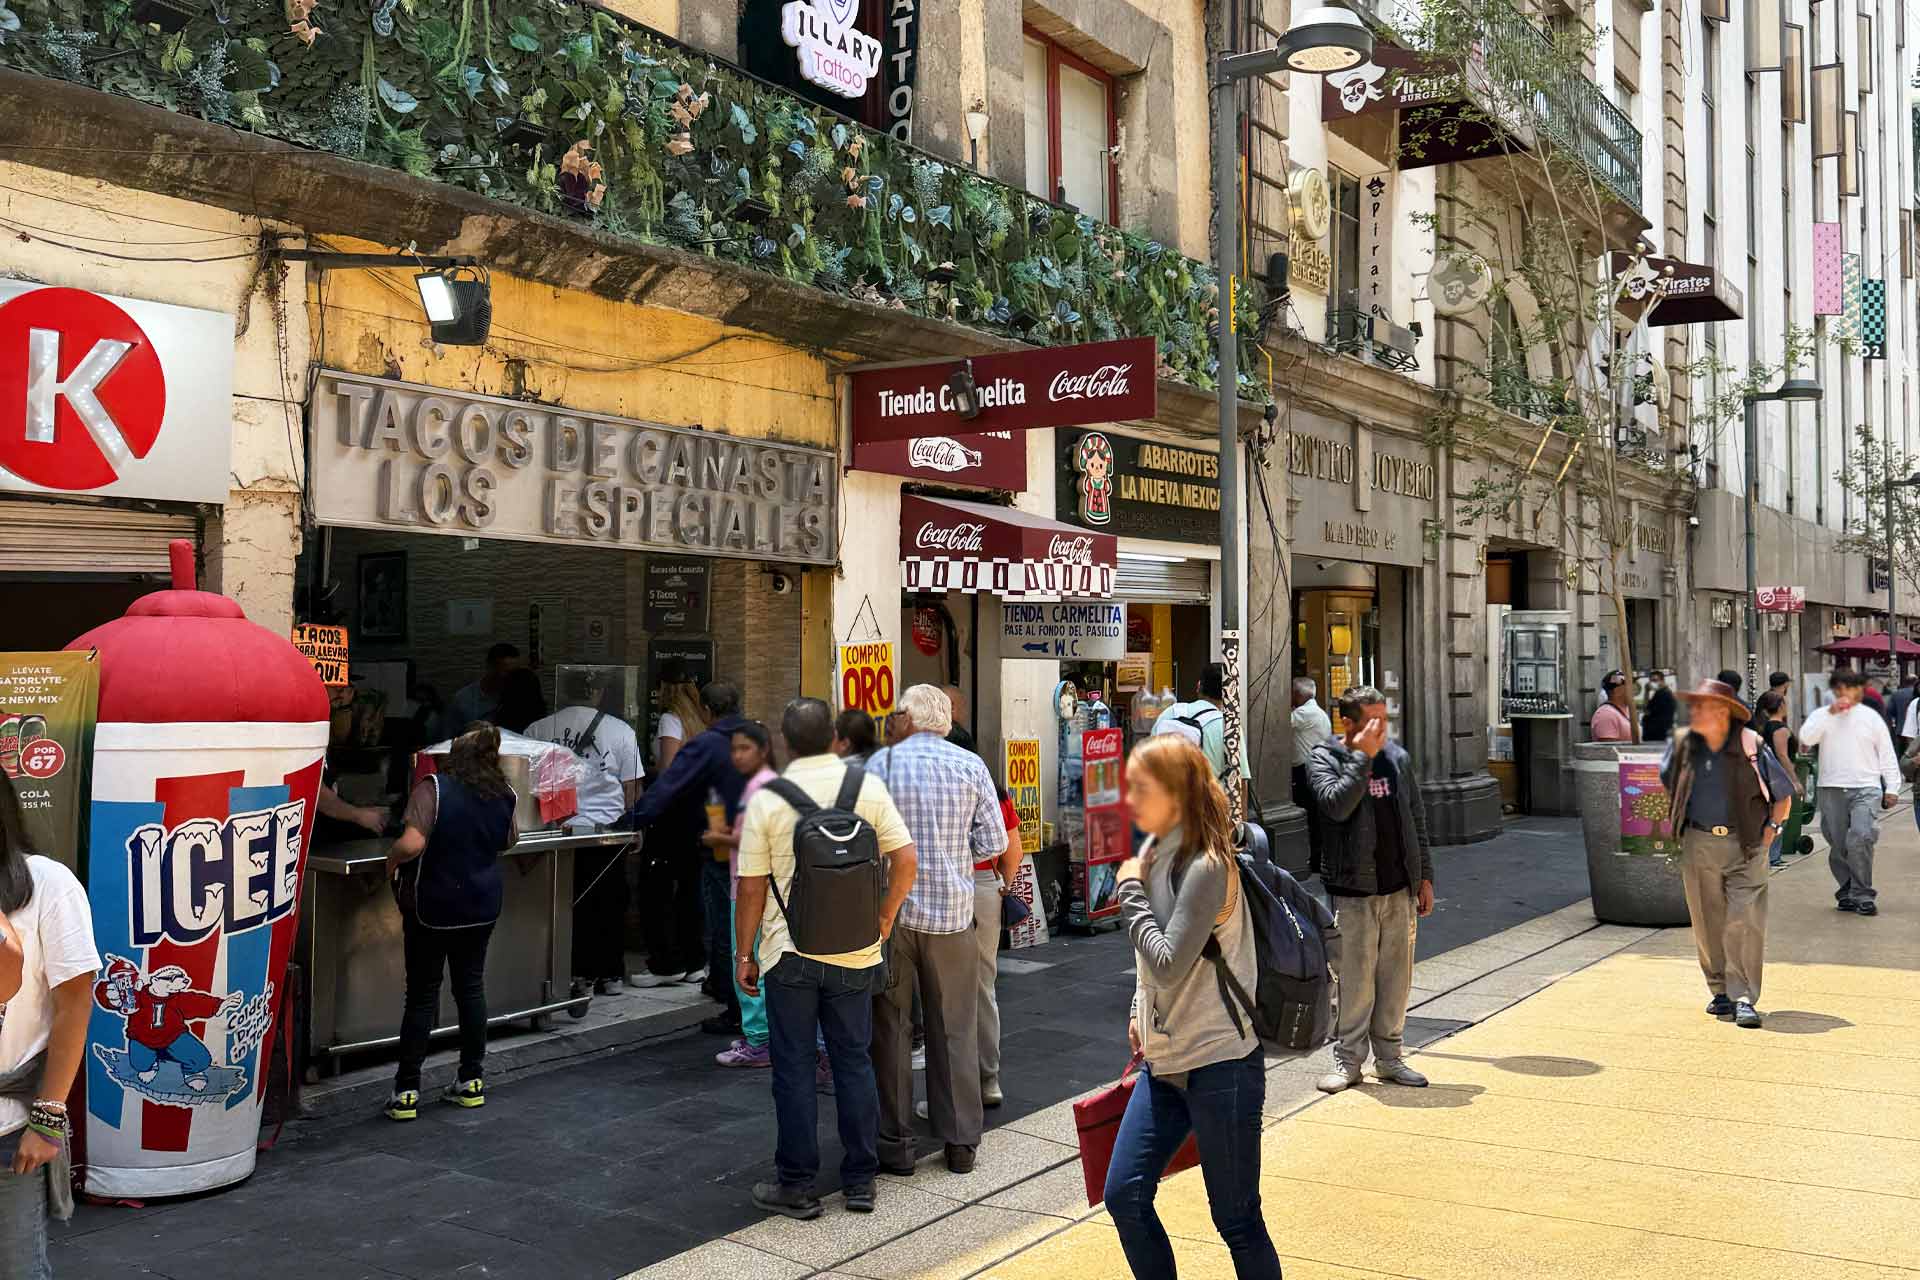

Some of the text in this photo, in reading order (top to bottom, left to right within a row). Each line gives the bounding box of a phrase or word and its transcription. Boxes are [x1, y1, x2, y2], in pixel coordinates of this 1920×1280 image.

[800, 10, 877, 69] ILLARY
[814, 51, 862, 89] Tattoo
[879, 378, 1026, 417] Tienda Cmelita
[1048, 363, 1133, 403] Coca-Cola
[333, 382, 826, 504] TACOS DE CANASTA
[1142, 444, 1219, 480] ABARROTES
[1371, 452, 1434, 501] JOYERO
[1120, 474, 1137, 500] LA
[1140, 477, 1180, 505] NUEVA
[382, 458, 824, 556] LOS ESPECIALES
[916, 521, 986, 551] Coca-Cola
[1049, 534, 1094, 564] Coca-Cola
[1324, 520, 1378, 549] MADERO
[1003, 605, 1122, 624] TIENDA CARMELITA
[297, 626, 341, 645] TACOS
[1004, 626, 1120, 637] PASE AL FONDO DEL PASILLO
[317, 646, 348, 660] LLEVAR
[846, 643, 887, 664] COMPRO
[315, 661, 344, 682] QUÍ.
[8, 696, 36, 704] NEW
[38, 696, 59, 704] MIX
[843, 665, 894, 711] ORO
[34, 747, 56, 755] POR
[1009, 743, 1036, 757] COMPRO
[1009, 759, 1036, 784] ORO
[20, 791, 50, 799] COLA
[130, 801, 305, 946] ICEE
[234, 1046, 248, 1059] in
